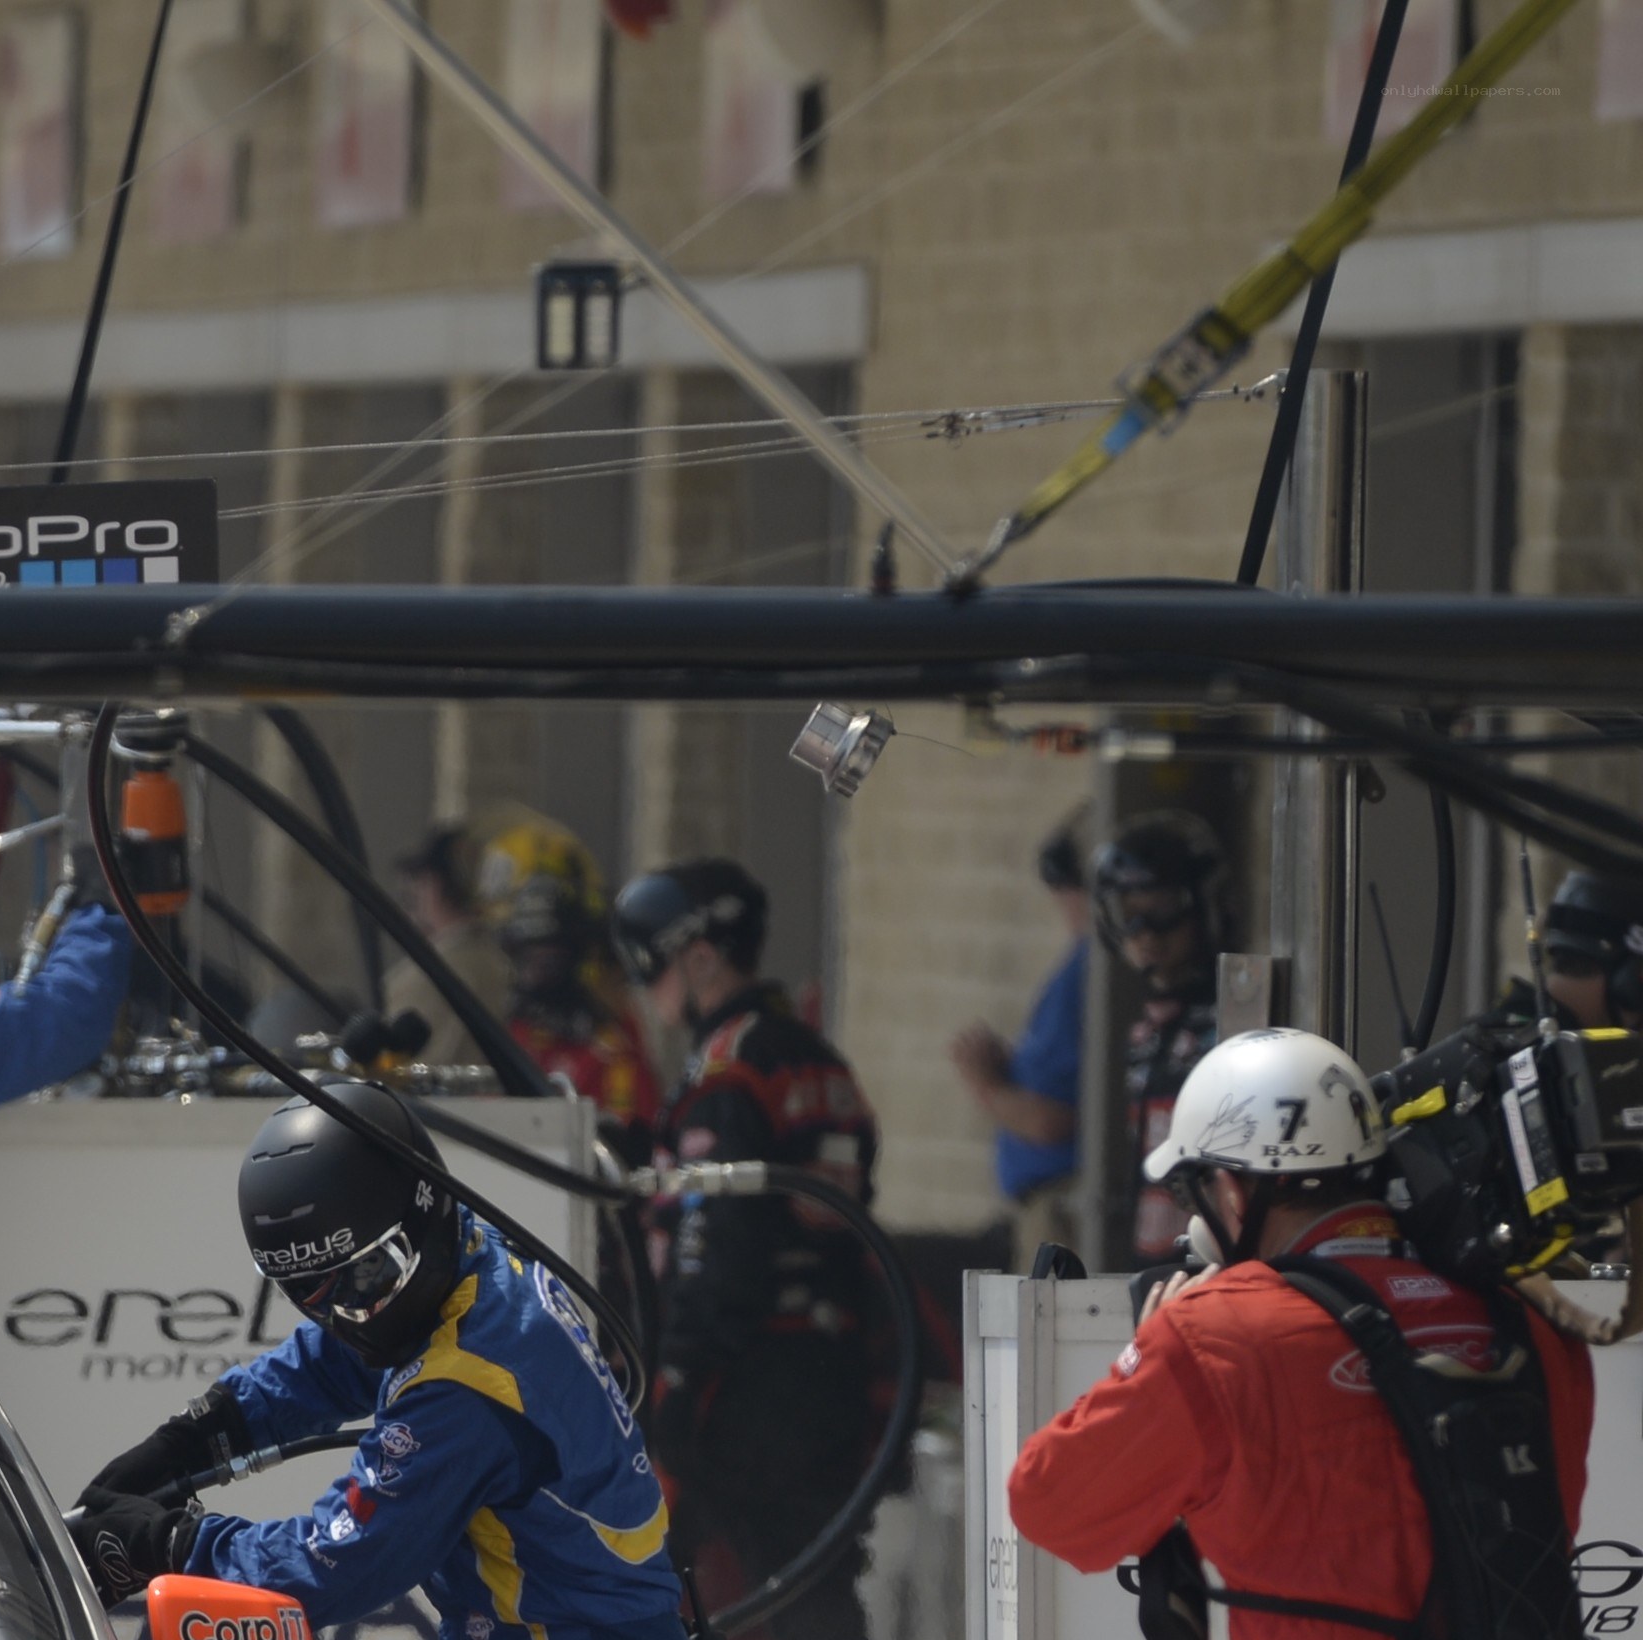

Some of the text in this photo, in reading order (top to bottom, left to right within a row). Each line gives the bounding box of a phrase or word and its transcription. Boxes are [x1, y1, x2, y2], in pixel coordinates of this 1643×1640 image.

[1276, 1097, 1310, 1144] 7
[1262, 1143, 1327, 1157] BAZ
[252, 1227, 354, 1268] erebus
